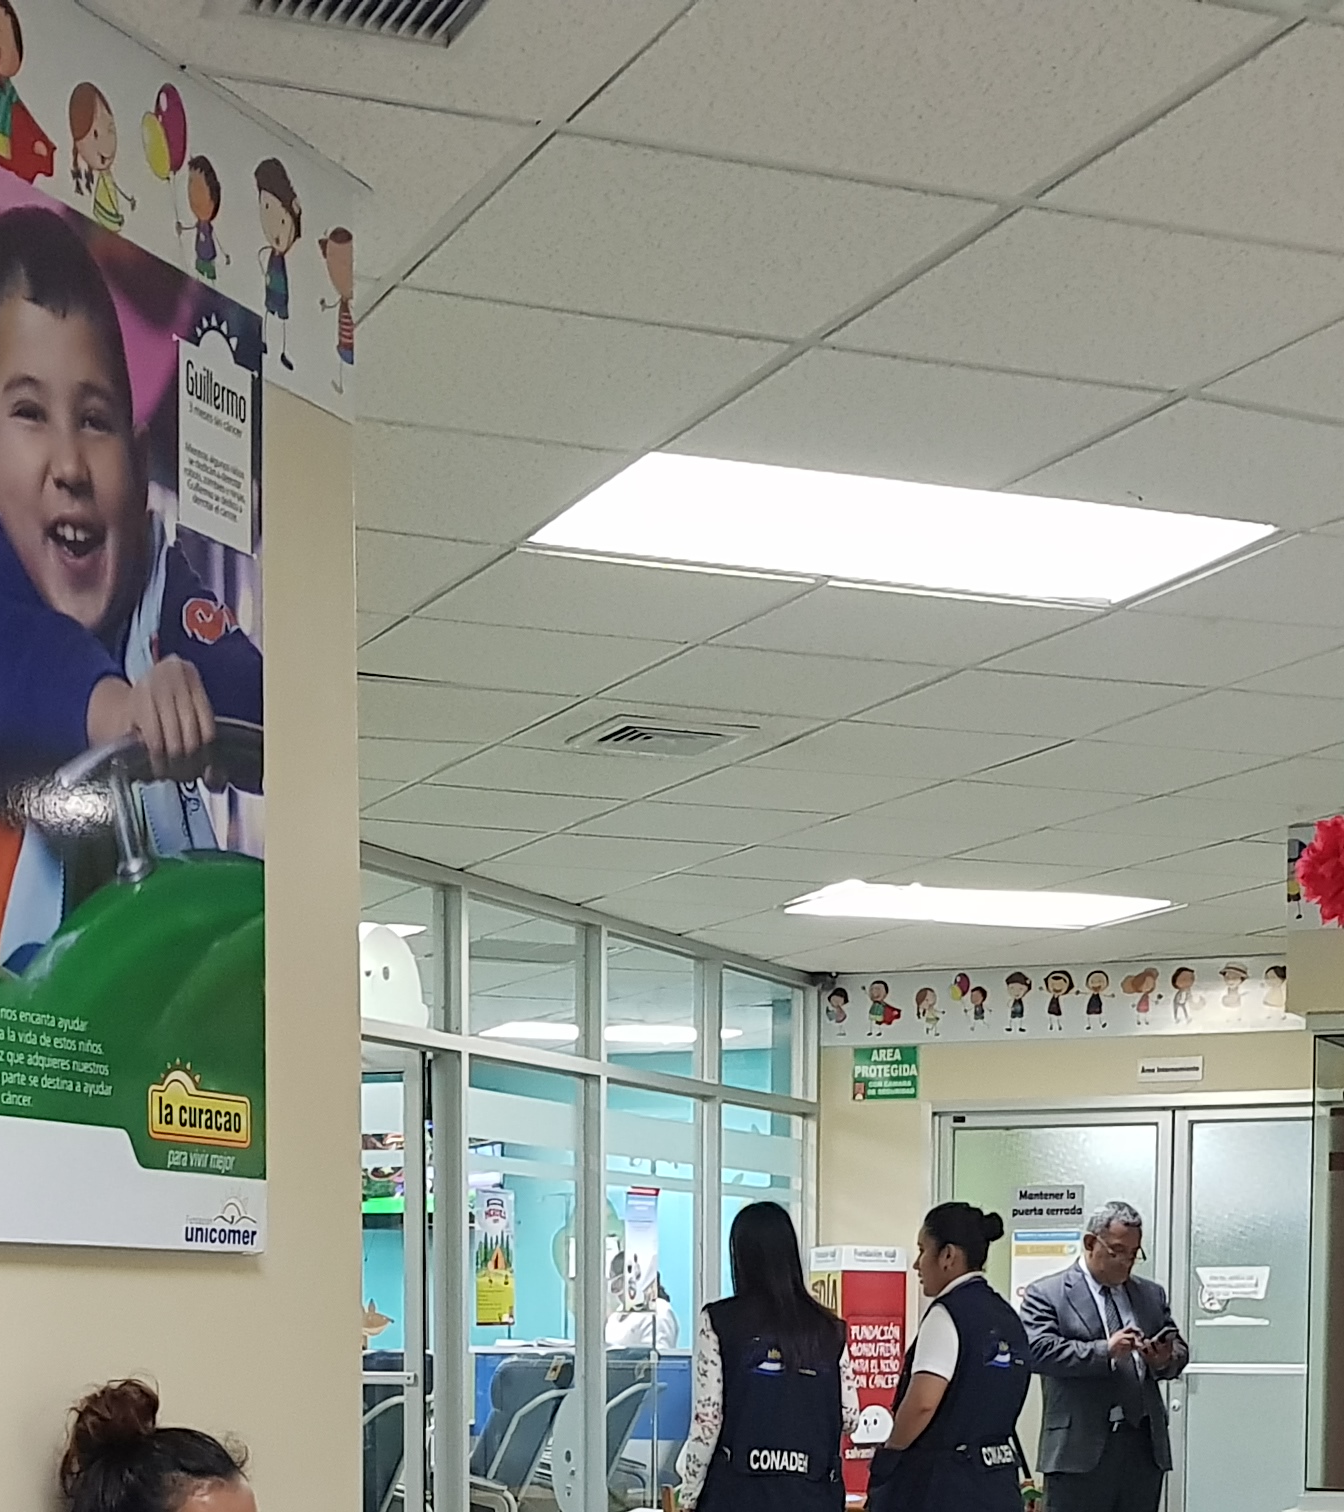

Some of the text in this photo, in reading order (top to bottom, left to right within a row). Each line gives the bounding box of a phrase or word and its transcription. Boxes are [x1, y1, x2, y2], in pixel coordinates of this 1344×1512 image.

[186, 359, 246, 423] Guillermo
[0, 1007, 17, 1021] nos
[20, 1010, 55, 1027] encanta
[58, 1017, 88, 1032] ayudar
[0, 1028, 4, 1039] a
[7, 1026, 15, 1042] la
[18, 1031, 37, 1045] vida
[40, 1033, 51, 1047] de
[54, 1037, 76, 1051] estos
[79, 1040, 104, 1055] niños.
[7, 1051, 25, 1066] que
[27, 1053, 70, 1071] adquieres
[72, 1060, 109, 1076] nuestros
[871, 1049, 901, 1061] AREA
[855, 1064, 918, 1078] PROTEGIDA
[2, 1071, 26, 1086] parte
[28, 1075, 38, 1087] se
[41, 1075, 73, 1092] destina
[75, 1081, 81, 1092] a
[83, 1081, 112, 1097] ayudar
[159, 1096, 241, 1133] la curacao
[167, 1149, 235, 1173] para vivir mejor
[1019, 1190, 1076, 1200] Mantener la
[1012, 1205, 1082, 1217] puerta cerrada
[185, 1226, 257, 1245] unicomer
[850, 1322, 900, 1340] FUNDACIÓN
[856, 1375, 867, 1388] ON
